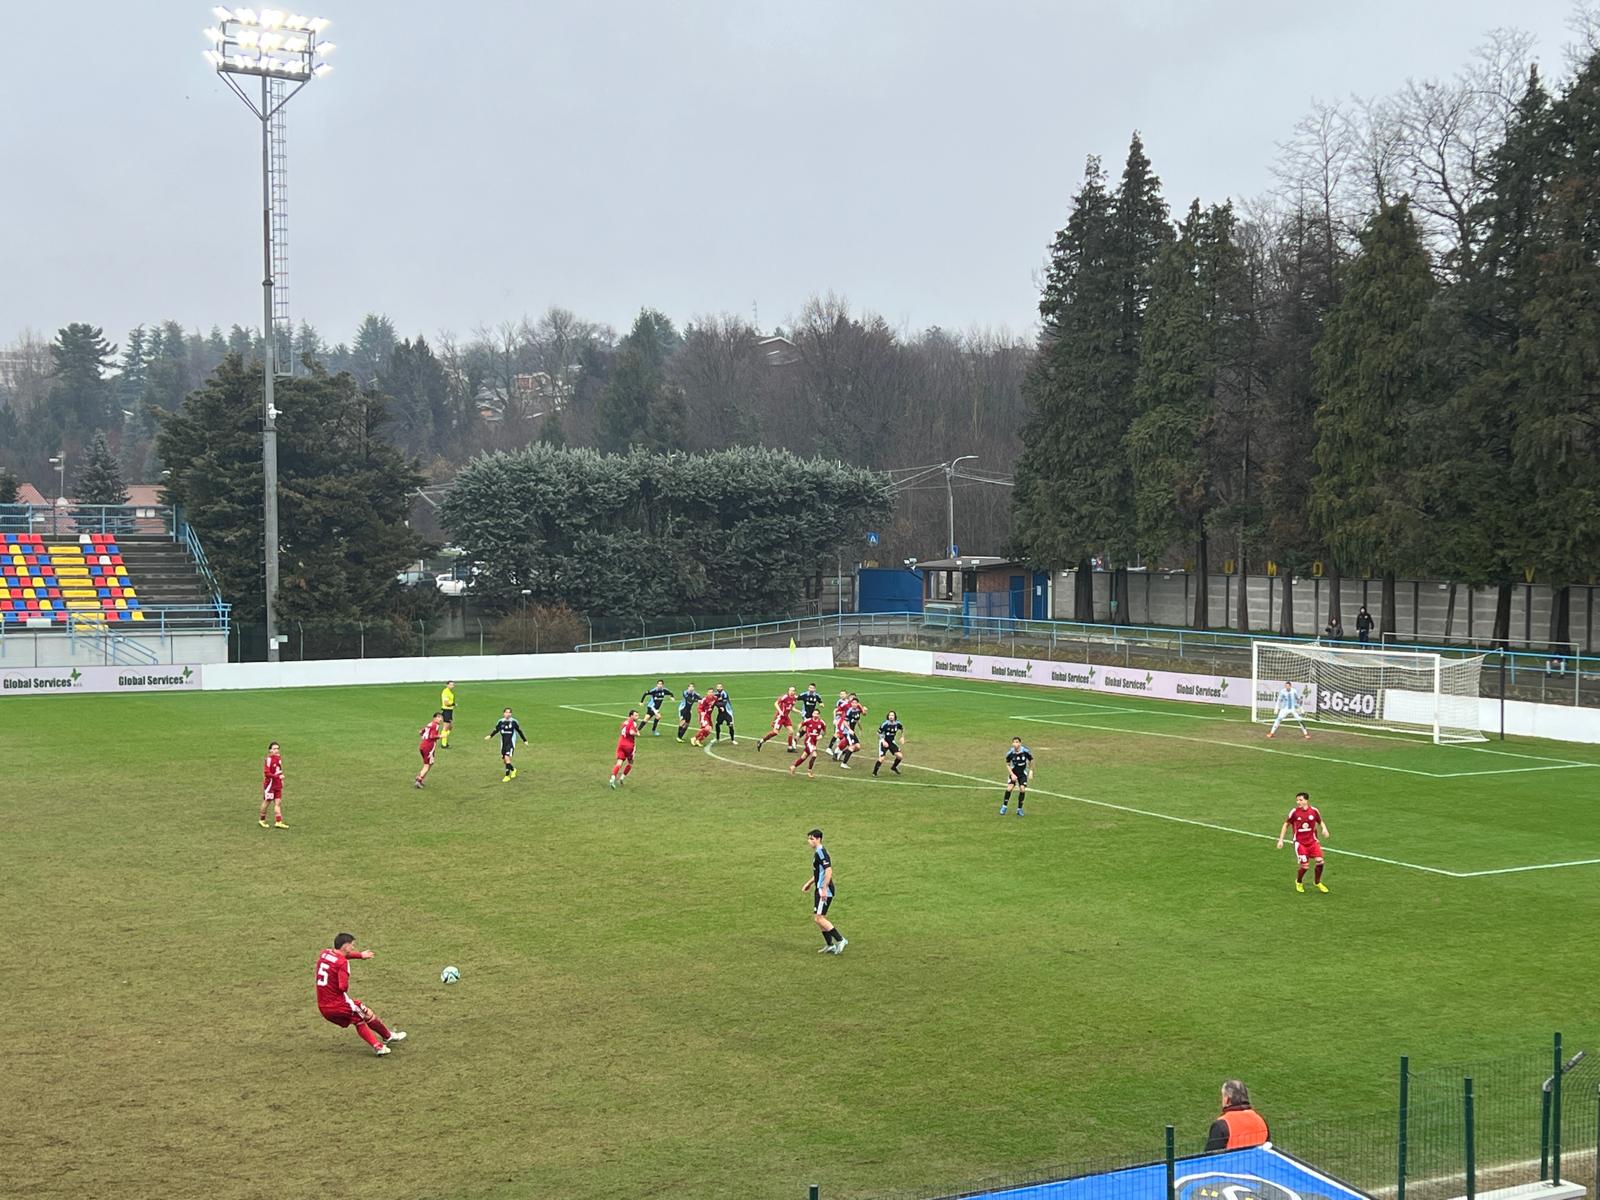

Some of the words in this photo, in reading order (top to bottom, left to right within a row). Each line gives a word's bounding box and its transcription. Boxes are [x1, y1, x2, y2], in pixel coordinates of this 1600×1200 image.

[935, 661, 948, 671] Global
[949, 662, 967, 672] Services
[991, 665, 1006, 675] Global
[1007, 667, 1027, 677] Services
[3, 678, 32, 689] Global
[33, 677, 72, 688] Services
[118, 675, 146, 686] Global
[147, 675, 184, 685] Services
[1051, 671, 1067, 681] Global
[1068, 673, 1090, 684] Services
[1105, 676, 1121, 687] Global
[1122, 678, 1146, 690] Services
[1176, 683, 1194, 695] Global
[1195, 685, 1221, 698] Services
[1319, 690, 1375, 714] 36:40
[318, 962, 329, 986] 5
